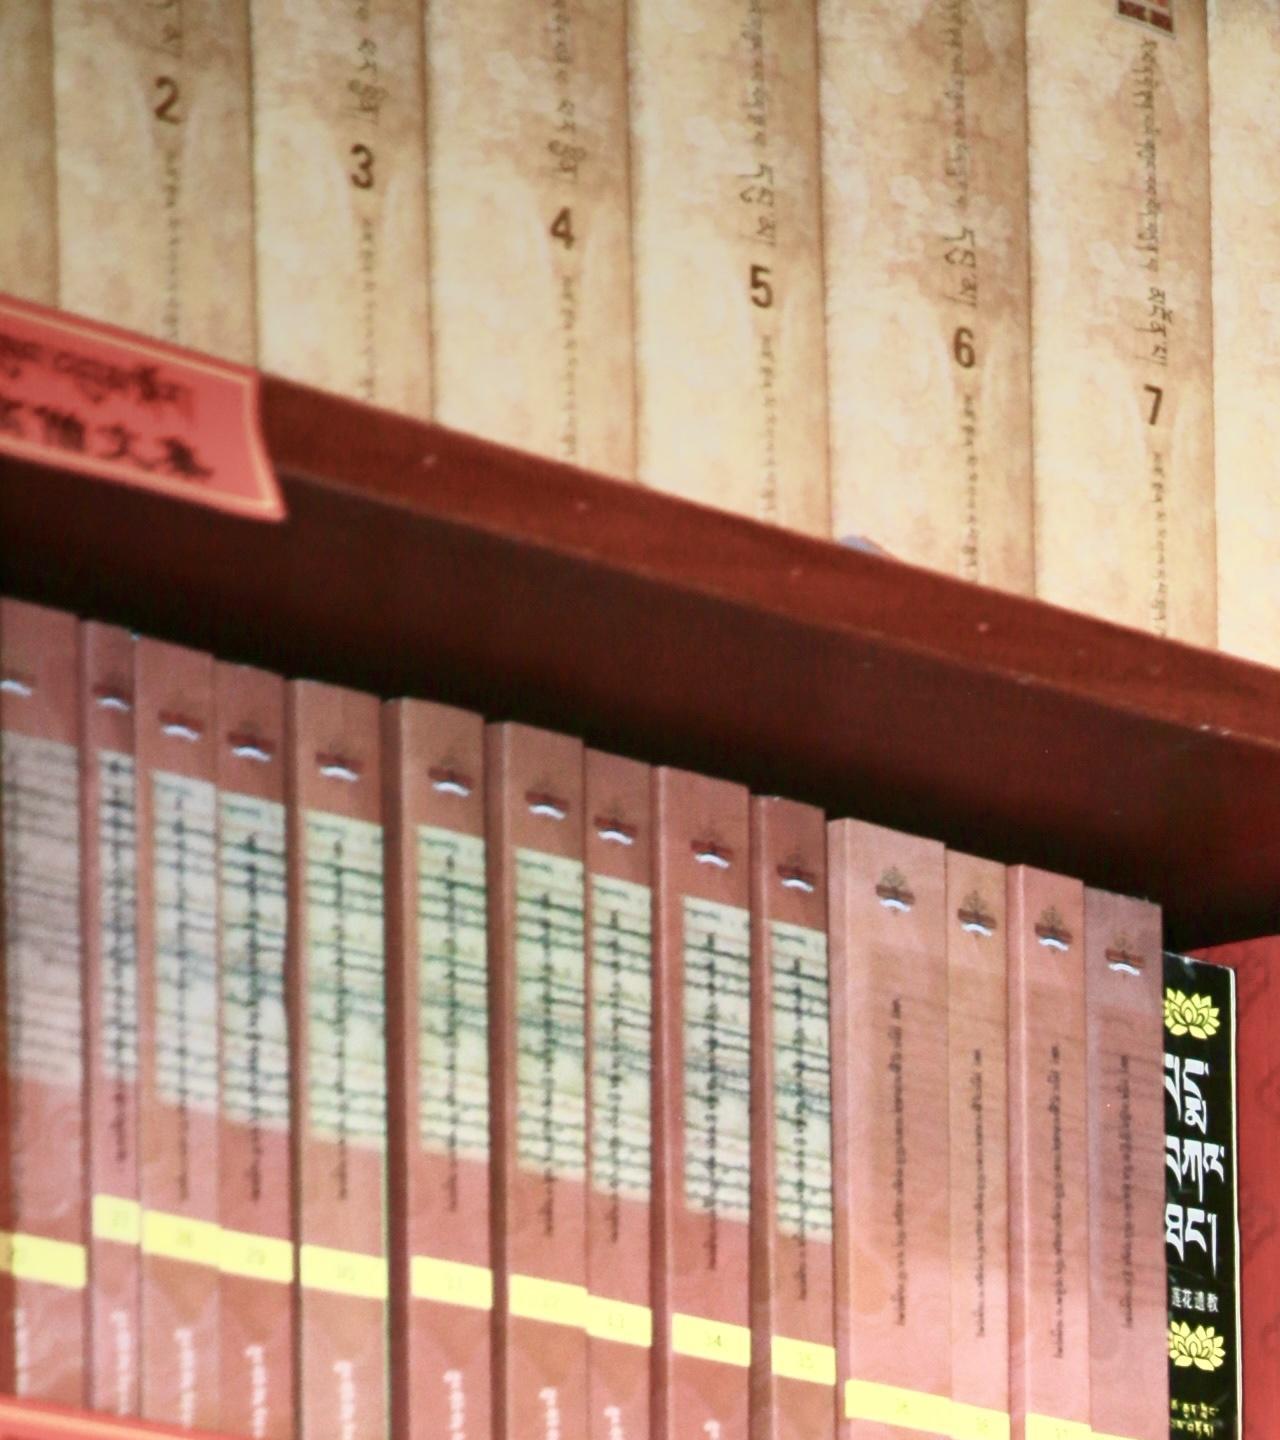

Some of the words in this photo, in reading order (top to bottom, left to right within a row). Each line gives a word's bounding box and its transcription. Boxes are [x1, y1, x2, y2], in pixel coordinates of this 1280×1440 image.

[154, 76, 181, 124] 2
[350, 144, 376, 190] 3
[550, 208, 577, 251] 4
[750, 265, 774, 309] 5
[953, 327, 976, 369] 6
[1143, 385, 1164, 427] 7
